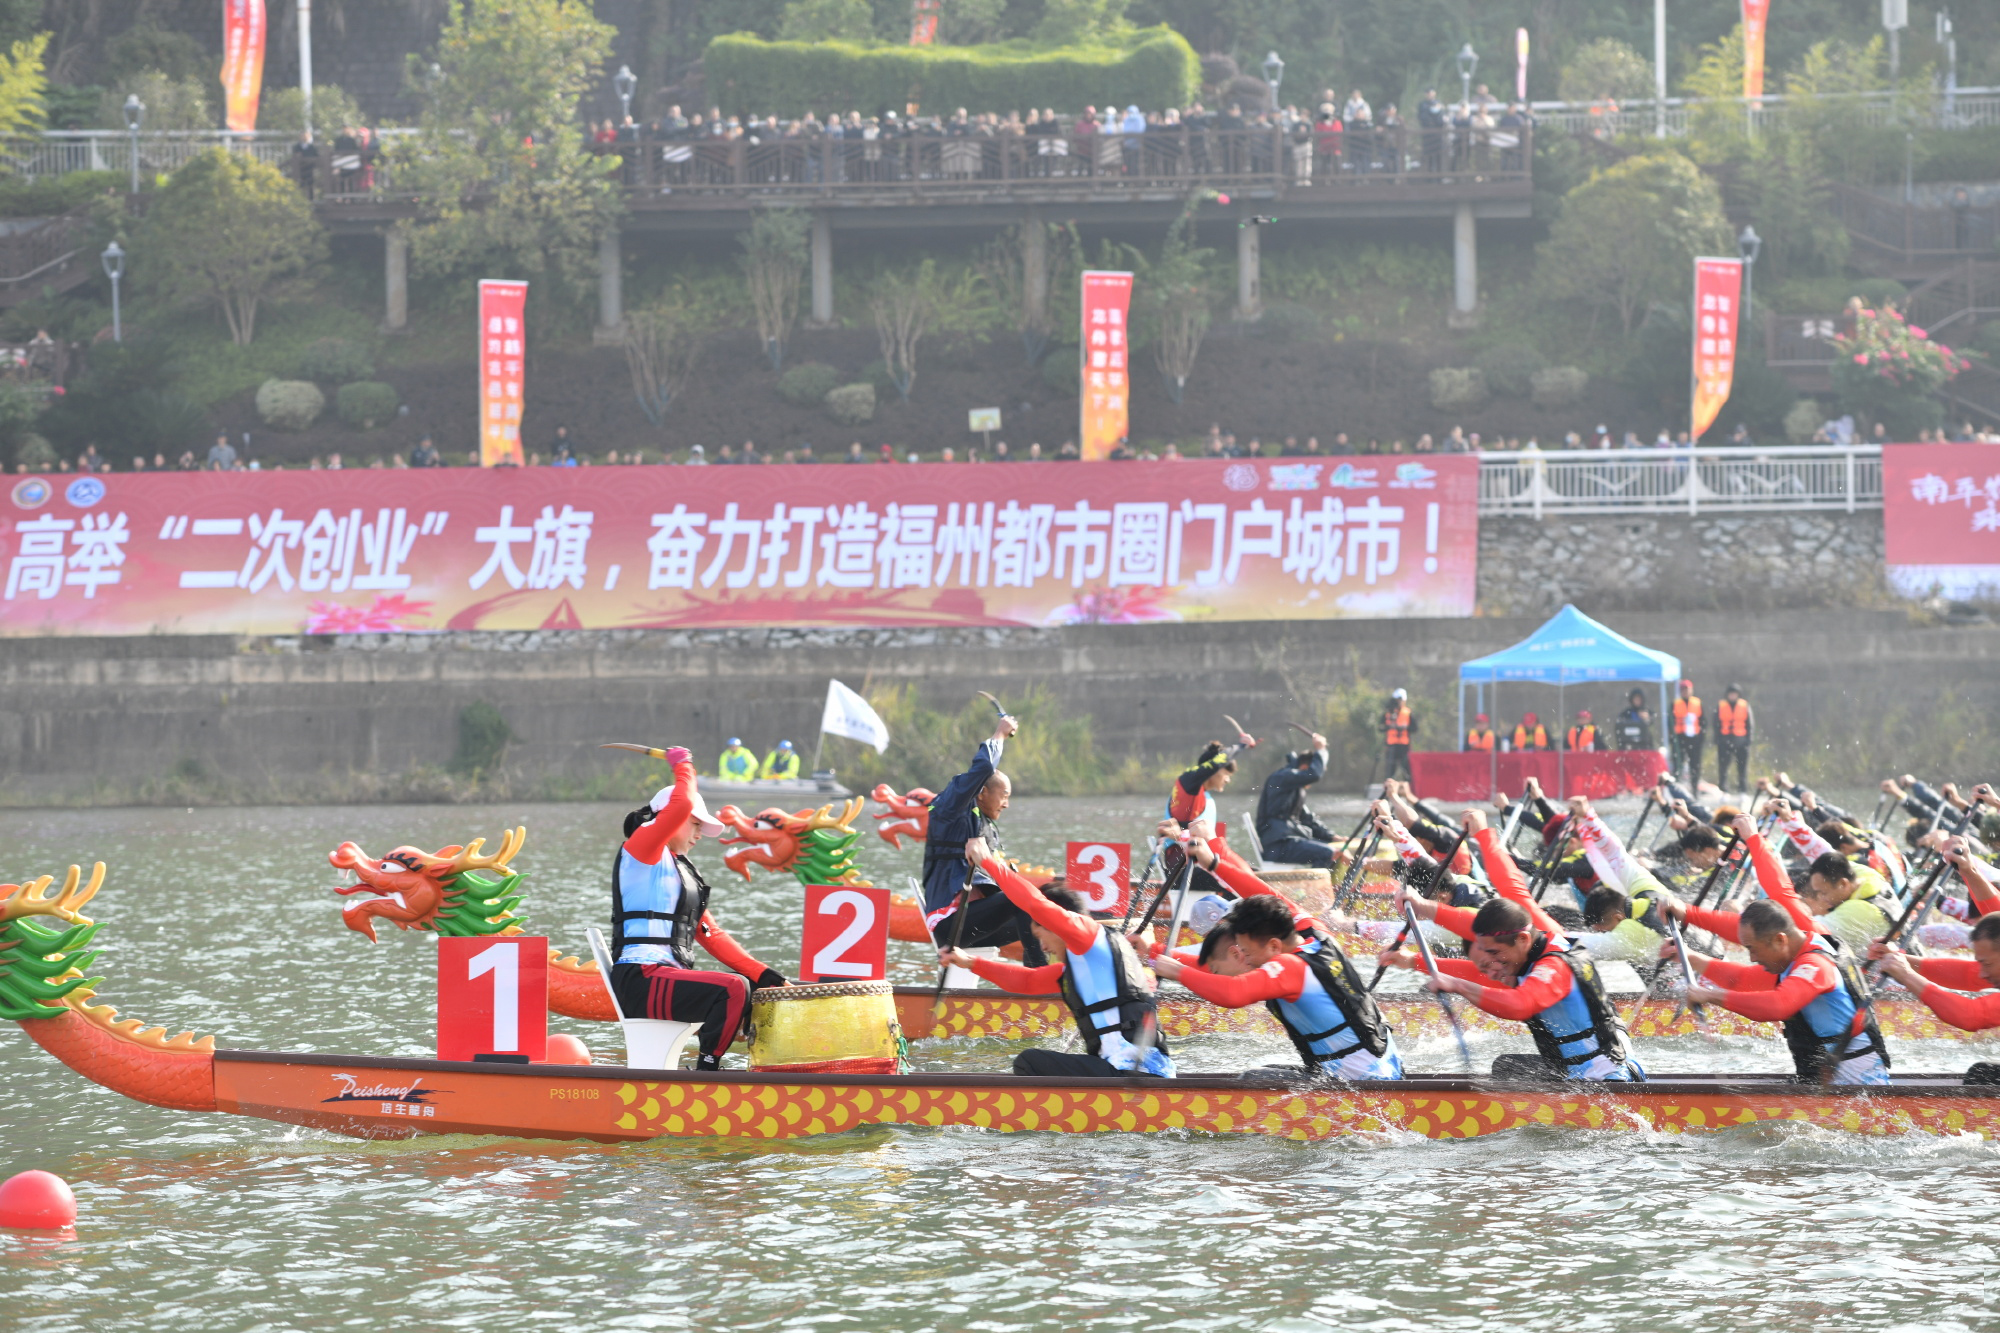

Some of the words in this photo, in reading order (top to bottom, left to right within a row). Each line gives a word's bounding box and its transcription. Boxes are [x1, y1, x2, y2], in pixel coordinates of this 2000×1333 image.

[1076, 844, 1120, 911] 3
[812, 890, 875, 977] 2
[468, 942, 519, 1052] 1
[331, 1073, 424, 1100] Peisheng
[550, 1088, 600, 1100] PS18108
